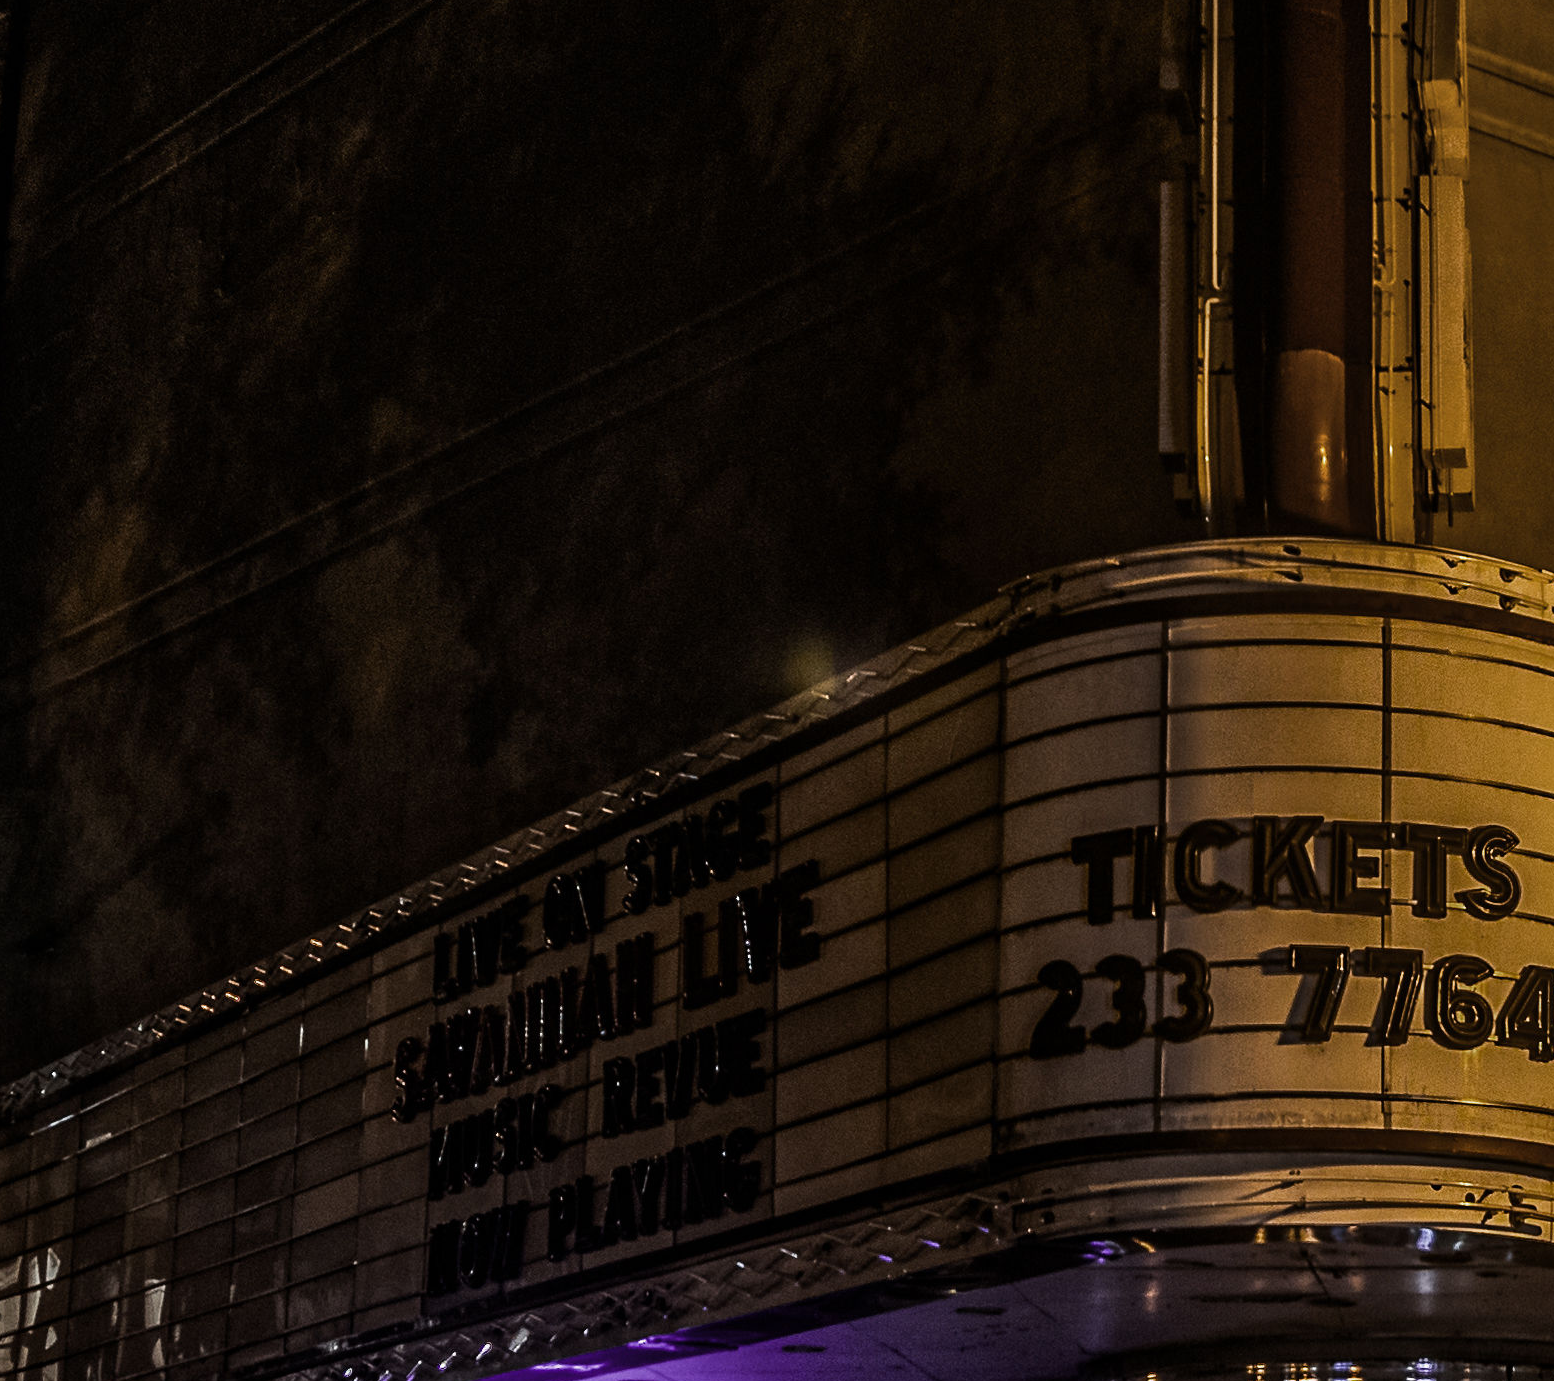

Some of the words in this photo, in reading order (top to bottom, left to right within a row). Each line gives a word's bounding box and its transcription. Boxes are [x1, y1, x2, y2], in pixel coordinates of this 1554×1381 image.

[433, 895, 529, 1003] LIVE
[545, 861, 605, 949] ON
[623, 781, 773, 914] STAGE
[1071, 815, 1521, 925] TICKETS
[391, 932, 654, 1123] SAVANNAH
[683, 860, 820, 1009] LIVE
[1029, 947, 1214, 1059] 233
[427, 1085, 561, 1201] MUSIC
[602, 1007, 767, 1138] REVUE
[426, 1200, 531, 1297] NOW
[548, 1127, 762, 1261] PLAYING
